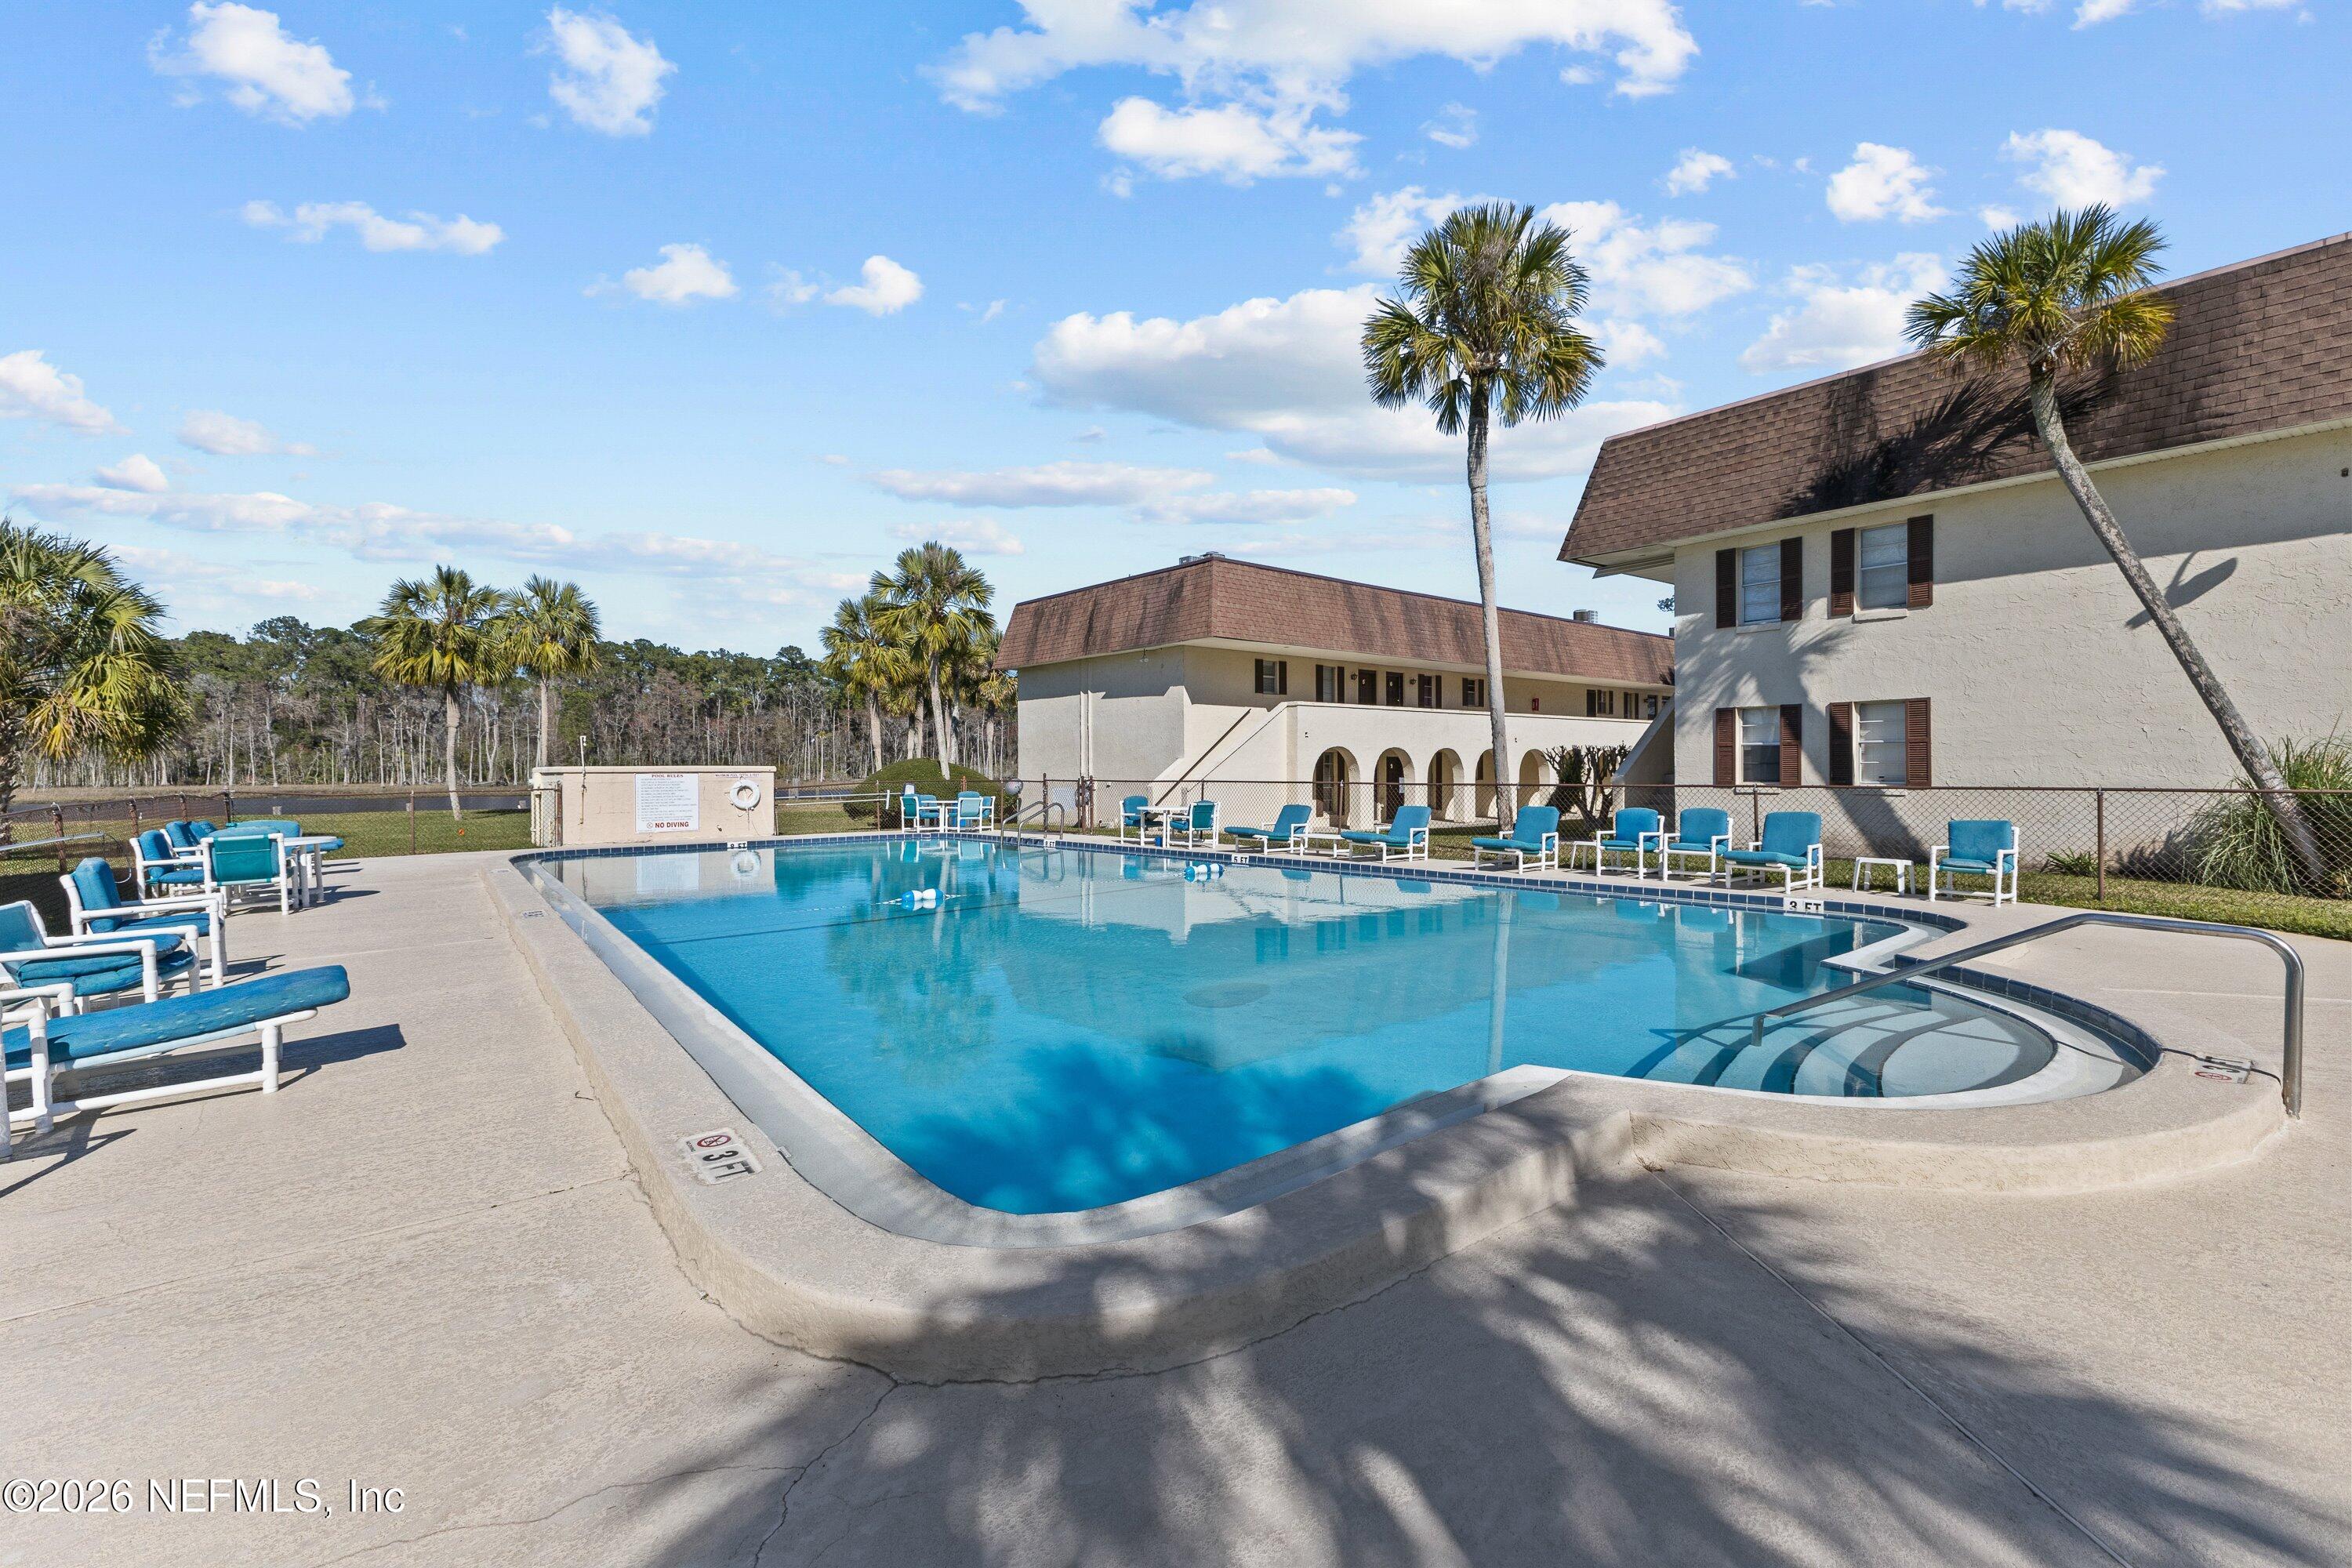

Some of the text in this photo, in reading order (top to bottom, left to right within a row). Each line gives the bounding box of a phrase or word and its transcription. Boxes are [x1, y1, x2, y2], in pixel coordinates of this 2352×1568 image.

[1789, 901, 1821, 912] 3 FT
[702, 1150, 755, 1179] 3 FT
